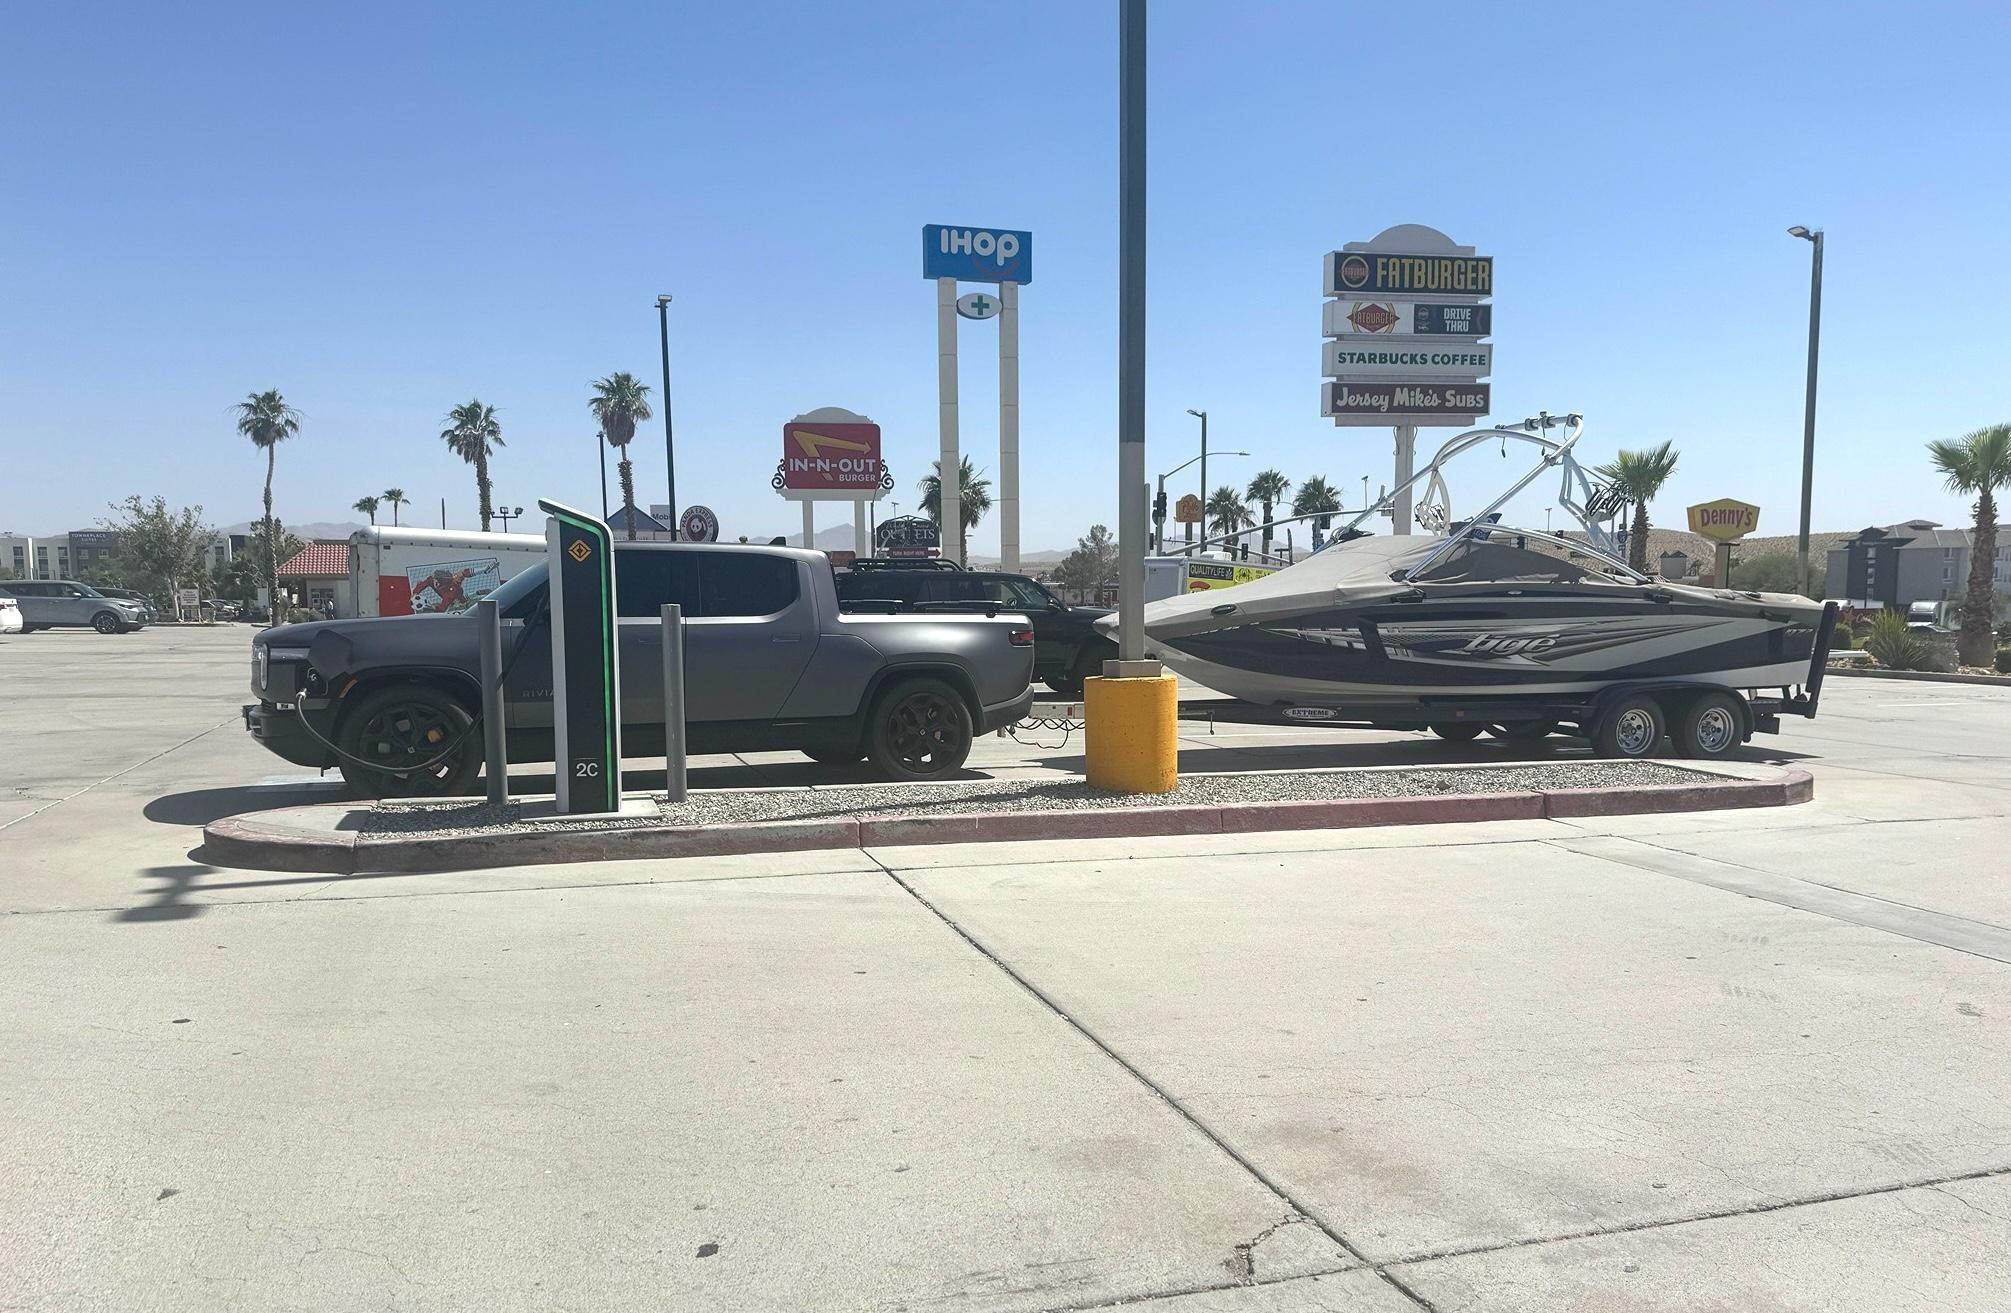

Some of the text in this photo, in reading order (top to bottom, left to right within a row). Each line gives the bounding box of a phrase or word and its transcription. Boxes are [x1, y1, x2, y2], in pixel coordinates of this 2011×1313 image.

[940, 228, 1020, 266] IHOP
[1376, 257, 1489, 290] FATBURGER
[1353, 311, 1394, 324] FATBURGER
[1443, 307, 1472, 320] DRIVE
[1445, 320, 1469, 332] THRU
[1337, 352, 1486, 366] STARBUCKS COFFEE
[1336, 387, 1390, 412] Jersey
[1393, 387, 1442, 408] Mike's
[789, 458, 876, 472] IN-N-OUT
[839, 474, 876, 482] BURGER
[1700, 507, 1753, 528] Denny's
[576, 762, 599, 777] 2C
